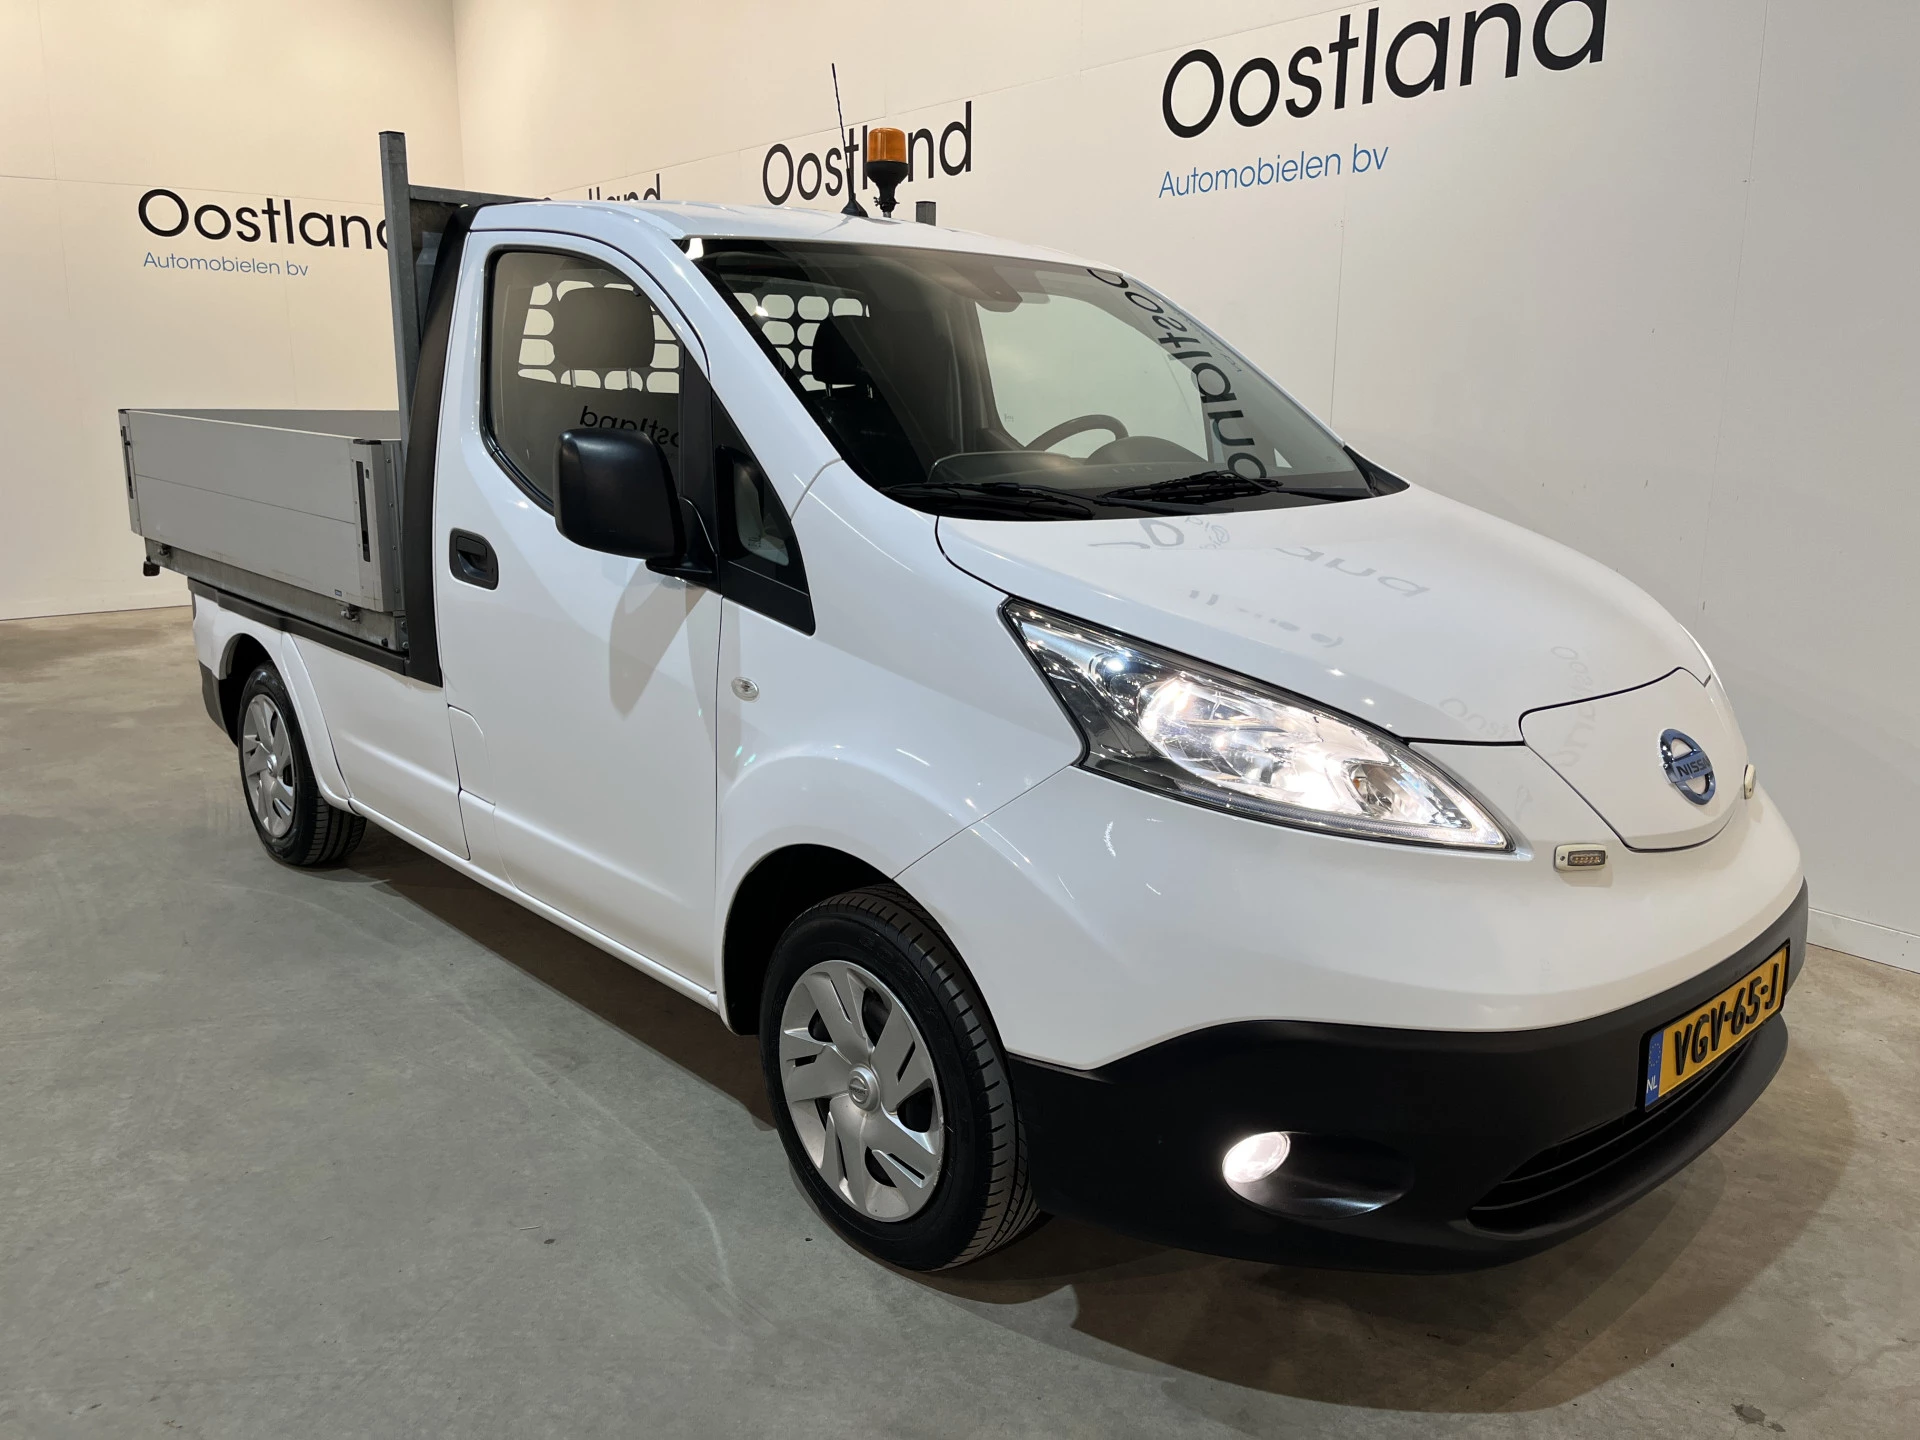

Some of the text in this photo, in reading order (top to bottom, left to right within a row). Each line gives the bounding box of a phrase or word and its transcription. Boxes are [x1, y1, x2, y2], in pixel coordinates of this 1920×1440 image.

[1162, 0, 1607, 138] Oostland
[762, 101, 972, 206] Oostlnd
[1158, 143, 1389, 198] Automobielen bv
[138, 188, 387, 250] Oostlan
[143, 251, 309, 277] Automobielen bv
[1674, 963, 1779, 1076] VGV-65-J
[1646, 1075, 1658, 1093] NL
